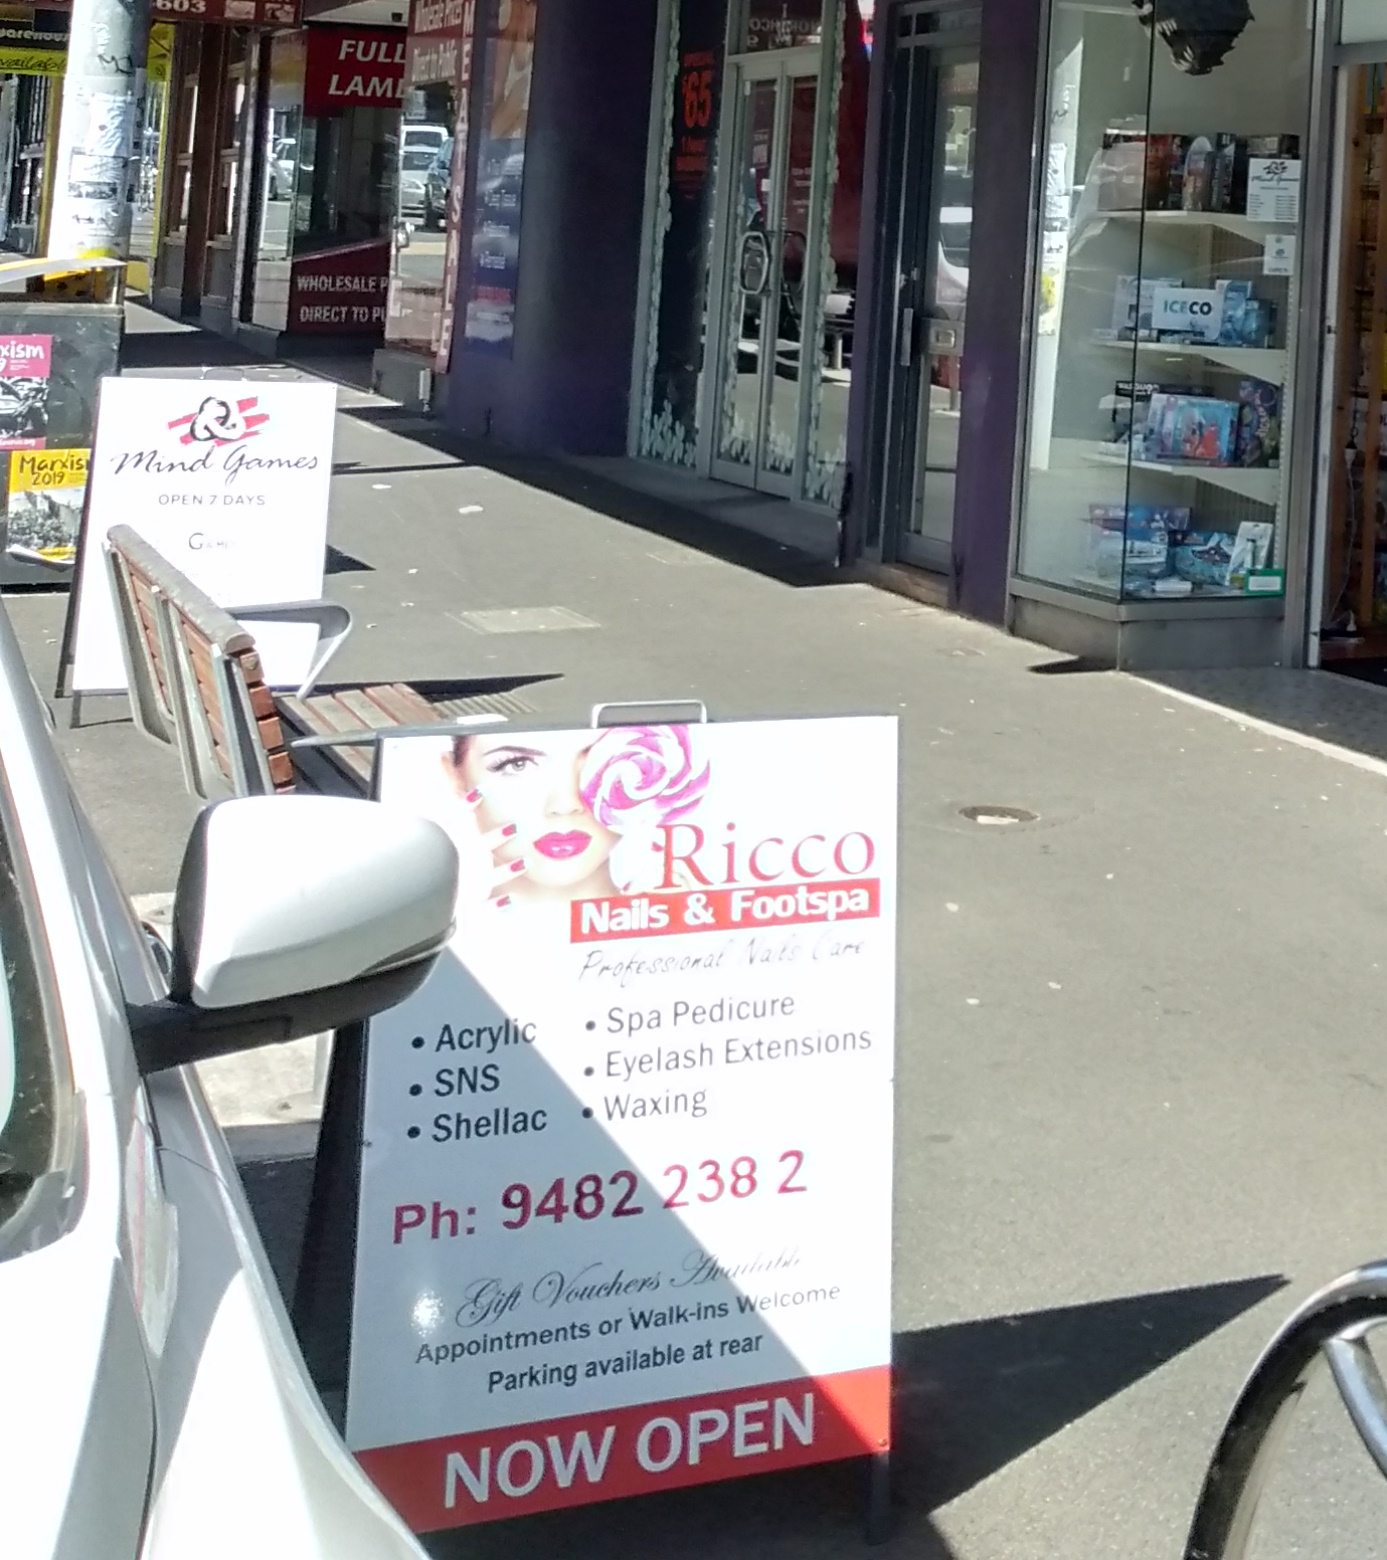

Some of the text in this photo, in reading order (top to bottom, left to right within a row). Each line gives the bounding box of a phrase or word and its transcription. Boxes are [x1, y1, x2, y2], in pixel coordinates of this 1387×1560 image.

[339, 38, 406, 63] FULL
[297, 276, 376, 292] WHOLESALE
[300, 306, 369, 322] DIRECT TO
[1163, 300, 1213, 316] ICECO
[20, 453, 89, 475] Marxis
[32, 470, 65, 486] 2019
[110, 444, 318, 487] Mind Games
[159, 494, 266, 506] OPEN 7 DAYS
[654, 822, 875, 890] Ricco
[581, 885, 869, 934] Nails & Footspa
[579, 939, 723, 988] Professional
[607, 990, 796, 1035] Spa Pedicure
[435, 1018, 537, 1055] Acrylic
[605, 1025, 872, 1082] Eyelash Extensions
[434, 1062, 500, 1098] SNS
[604, 1086, 708, 1122] Waxing
[431, 1106, 548, 1145] Shellac
[393, 1148, 809, 1245] Ph: 9482 238 2
[456, 1277, 523, 1328] Gift
[533, 1262, 661, 1309] Vouchers
[415, 1284, 841, 1365] Appointments or Walk-ins Welcome
[488, 1332, 763, 1394] Parking available at rear
[444, 1392, 816, 1509] NOW OPEN
